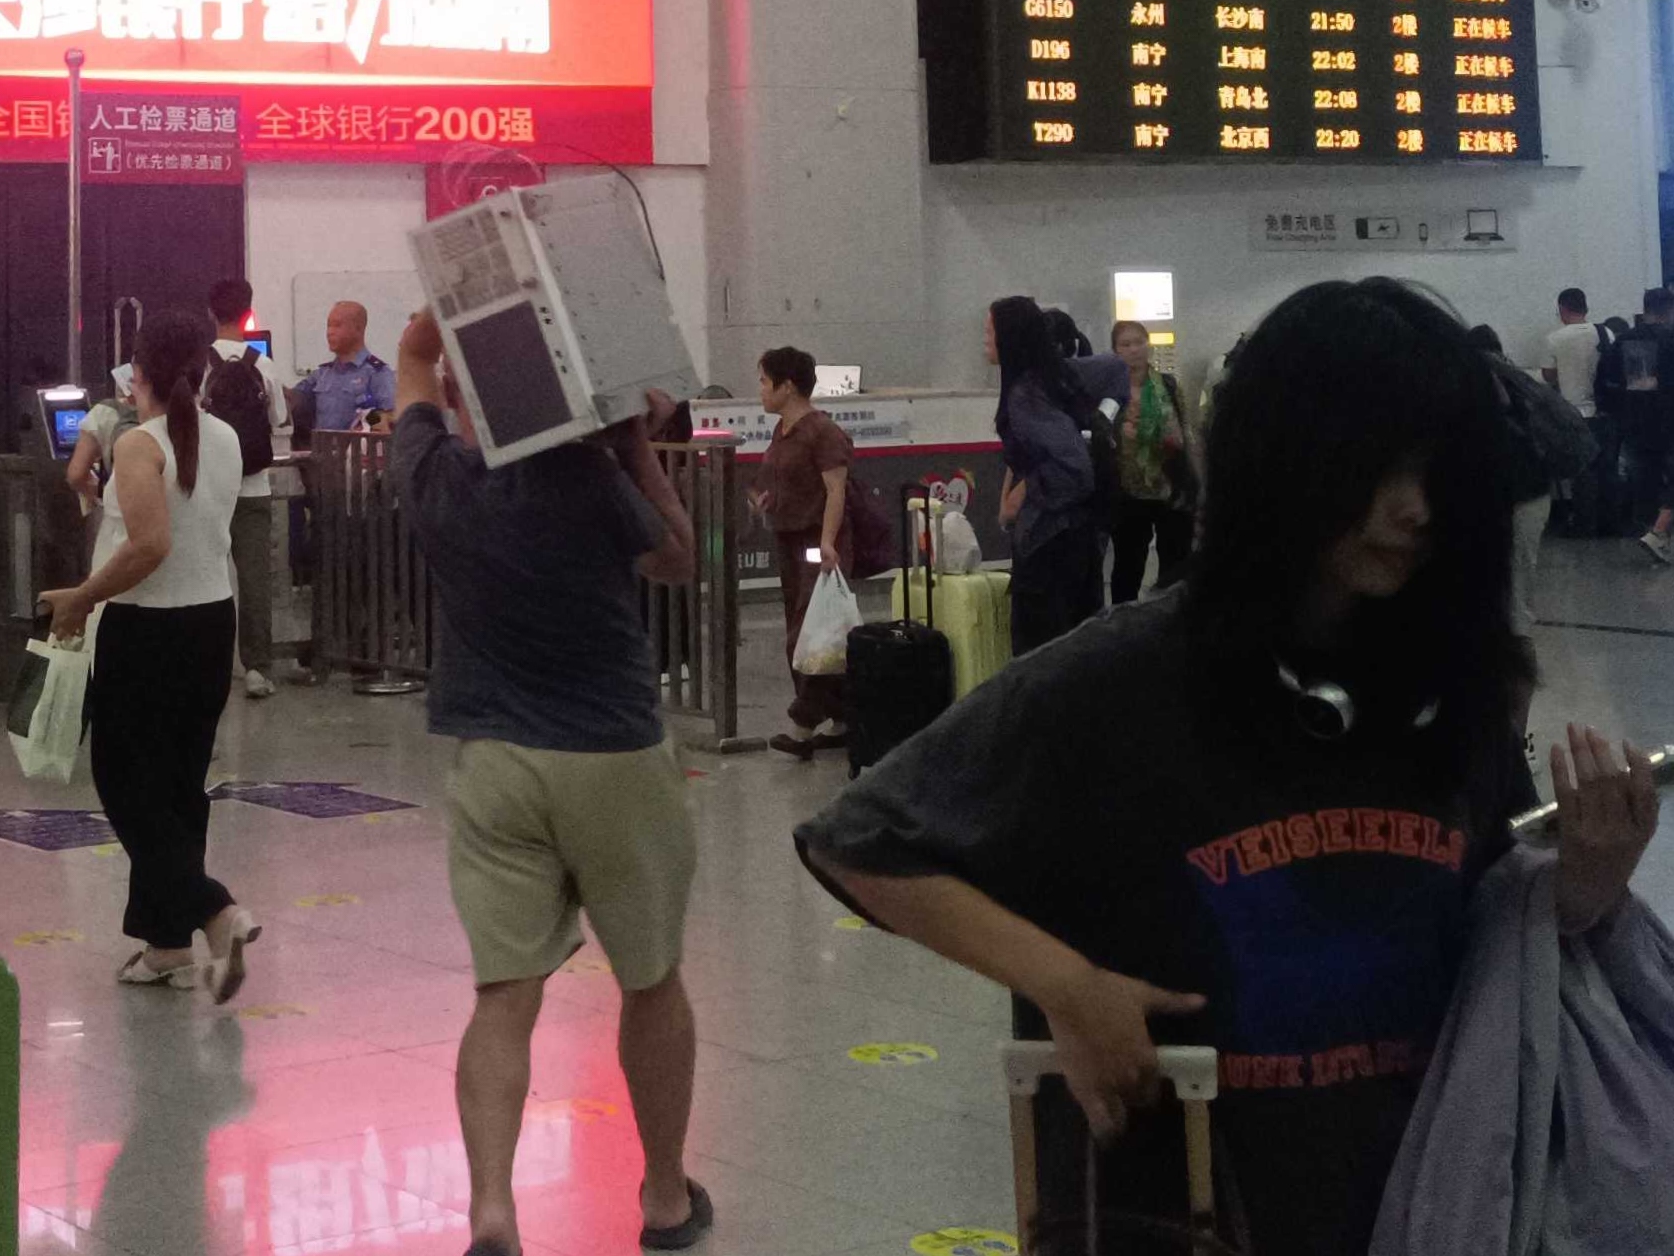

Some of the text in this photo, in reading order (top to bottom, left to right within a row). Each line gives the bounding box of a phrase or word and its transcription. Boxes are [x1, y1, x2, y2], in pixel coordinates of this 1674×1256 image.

[1131, 3, 1164, 25] 永州
[1216, 6, 1264, 30] 长沙南
[1311, 13, 1354, 32] 21:50
[1454, 18, 1512, 40] 正在候车
[1031, 39, 1070, 59] D196
[1132, 43, 1166, 66] 南宁
[1219, 46, 1265, 69] 上海南
[1312, 51, 1355, 70] 22:02
[1455, 55, 1514, 77] 正在候车
[1028, 81, 1076, 100] K1138
[1133, 84, 1167, 106] 南宁
[1219, 86, 1269, 109] 青岛北
[1315, 90, 1357, 109] 22:08
[1457, 93, 1515, 115] 正在候车
[89, 103, 237, 134] 人工检票通道
[256, 102, 535, 143] 全球银行200强
[1035, 122, 1072, 142] T290
[1135, 125, 1169, 148] 南宁
[1221, 126, 1269, 150] 北京西
[1316, 129, 1359, 149] 22:20
[1459, 131, 1517, 153] 正在候车
